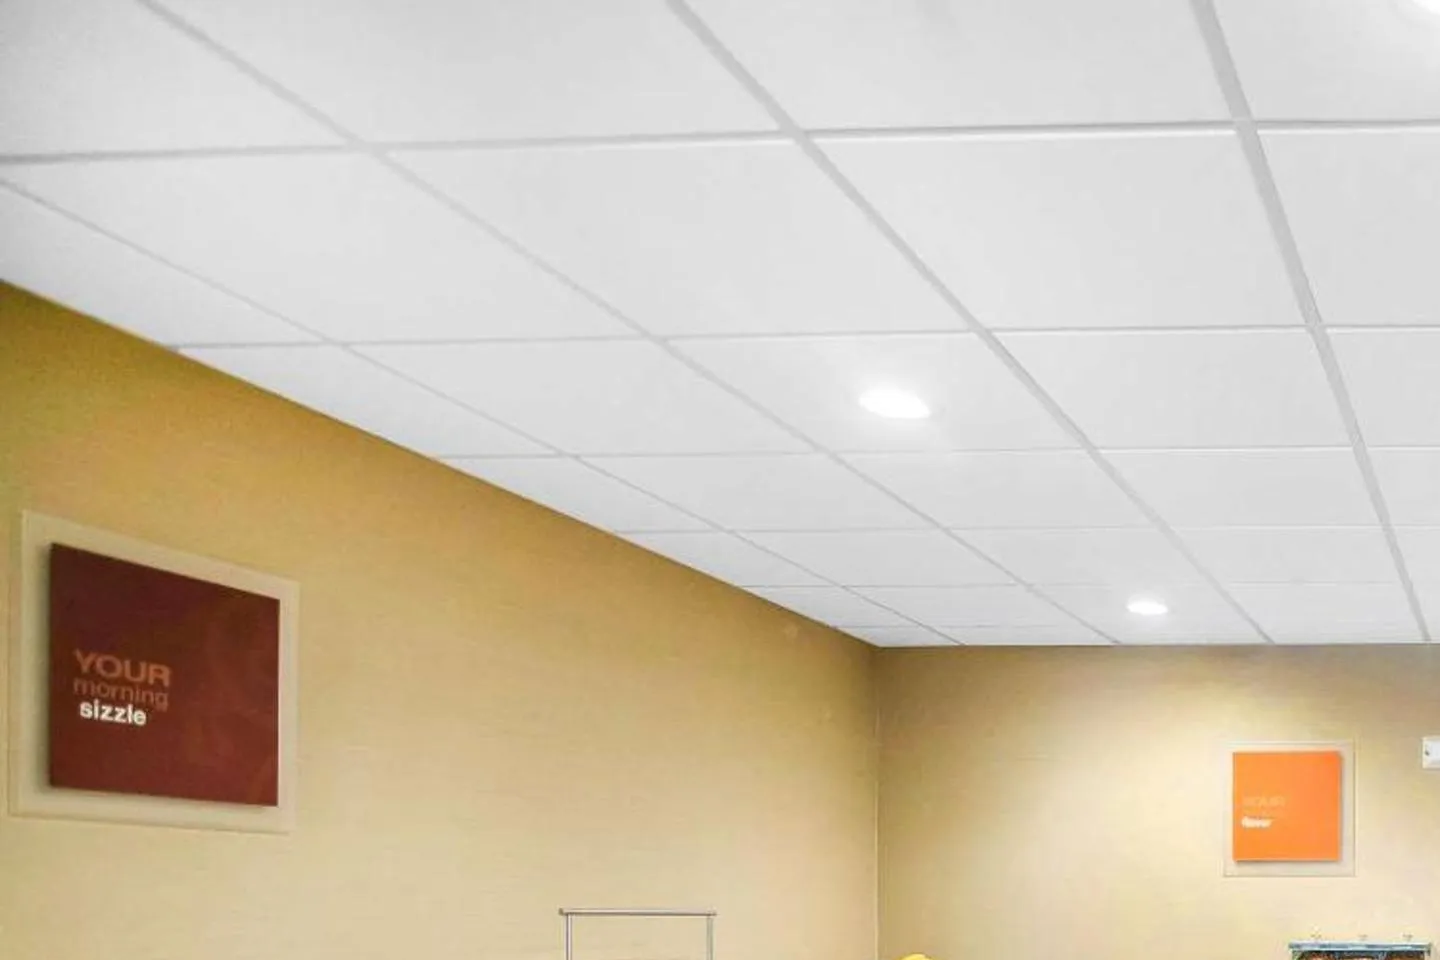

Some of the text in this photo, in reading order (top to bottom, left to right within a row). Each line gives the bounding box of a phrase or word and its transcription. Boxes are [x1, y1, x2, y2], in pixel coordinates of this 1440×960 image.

[73, 649, 171, 687] YOUR
[73, 678, 168, 712] morning
[79, 698, 147, 726] sizzle
